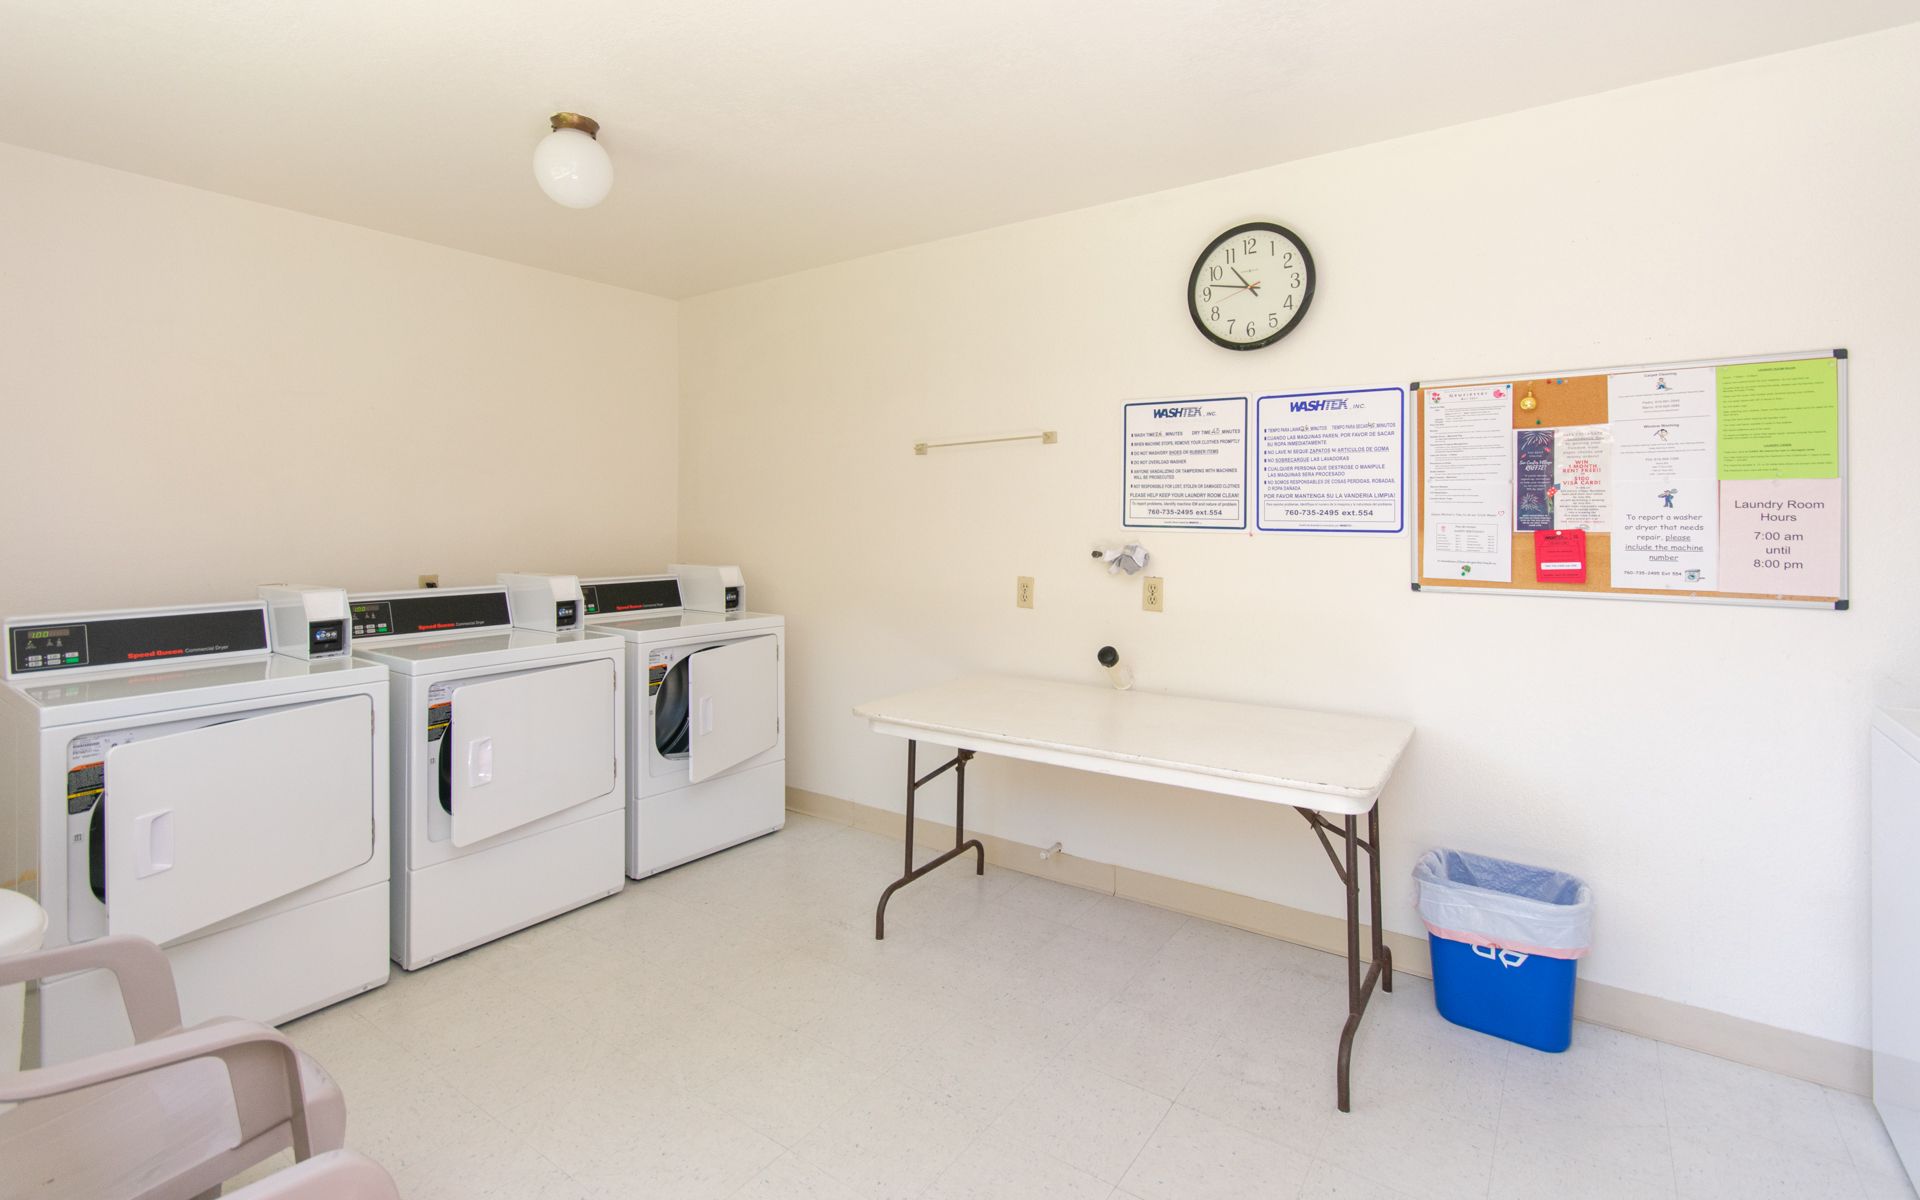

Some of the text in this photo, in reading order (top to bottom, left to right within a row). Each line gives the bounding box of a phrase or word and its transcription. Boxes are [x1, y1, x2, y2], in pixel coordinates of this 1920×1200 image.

[1242, 238, 1257, 255] 12
[1270, 240, 1275, 257] 1
[1225, 248, 1236, 265] 11
[1283, 252, 1293, 269] 2
[1209, 265, 1223, 282] 10
[1290, 272, 1301, 289] 3
[1202, 286, 1212, 303] 9
[1283, 294, 1294, 311] 4
[1211, 305, 1220, 322] 8
[1268, 312, 1279, 329] 5
[1227, 319, 1236, 335] 7
[1246, 321, 1256, 337] 6
[1734, 500, 1824, 511] Laundry Room
[1760, 513, 1797, 522] Hours
[1754, 532, 1780, 540] 7:00
[1766, 546, 1790, 554] until
[1753, 559, 1804, 571] 8:00 pm
[128, 651, 156, 660] Speed
